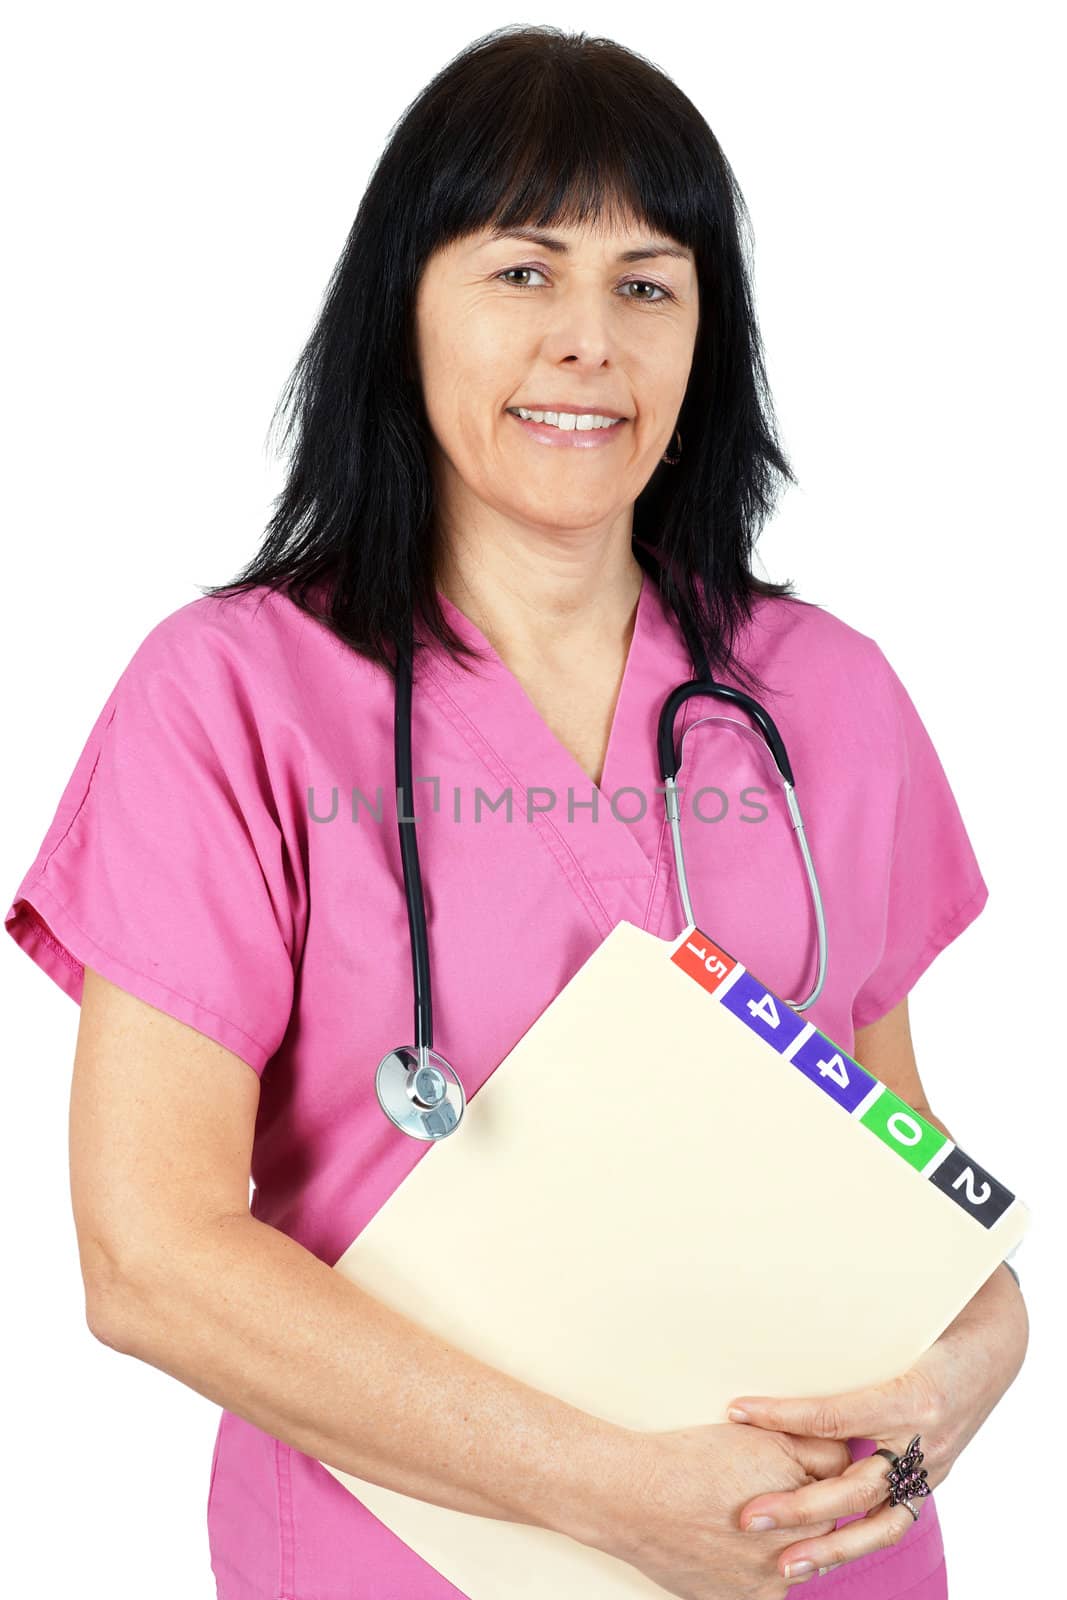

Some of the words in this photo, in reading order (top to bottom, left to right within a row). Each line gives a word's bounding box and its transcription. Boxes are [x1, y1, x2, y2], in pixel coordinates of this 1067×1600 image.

[746, 993, 781, 1029] 4
[815, 1053, 850, 1089] 4
[951, 1166, 992, 1205] 2
